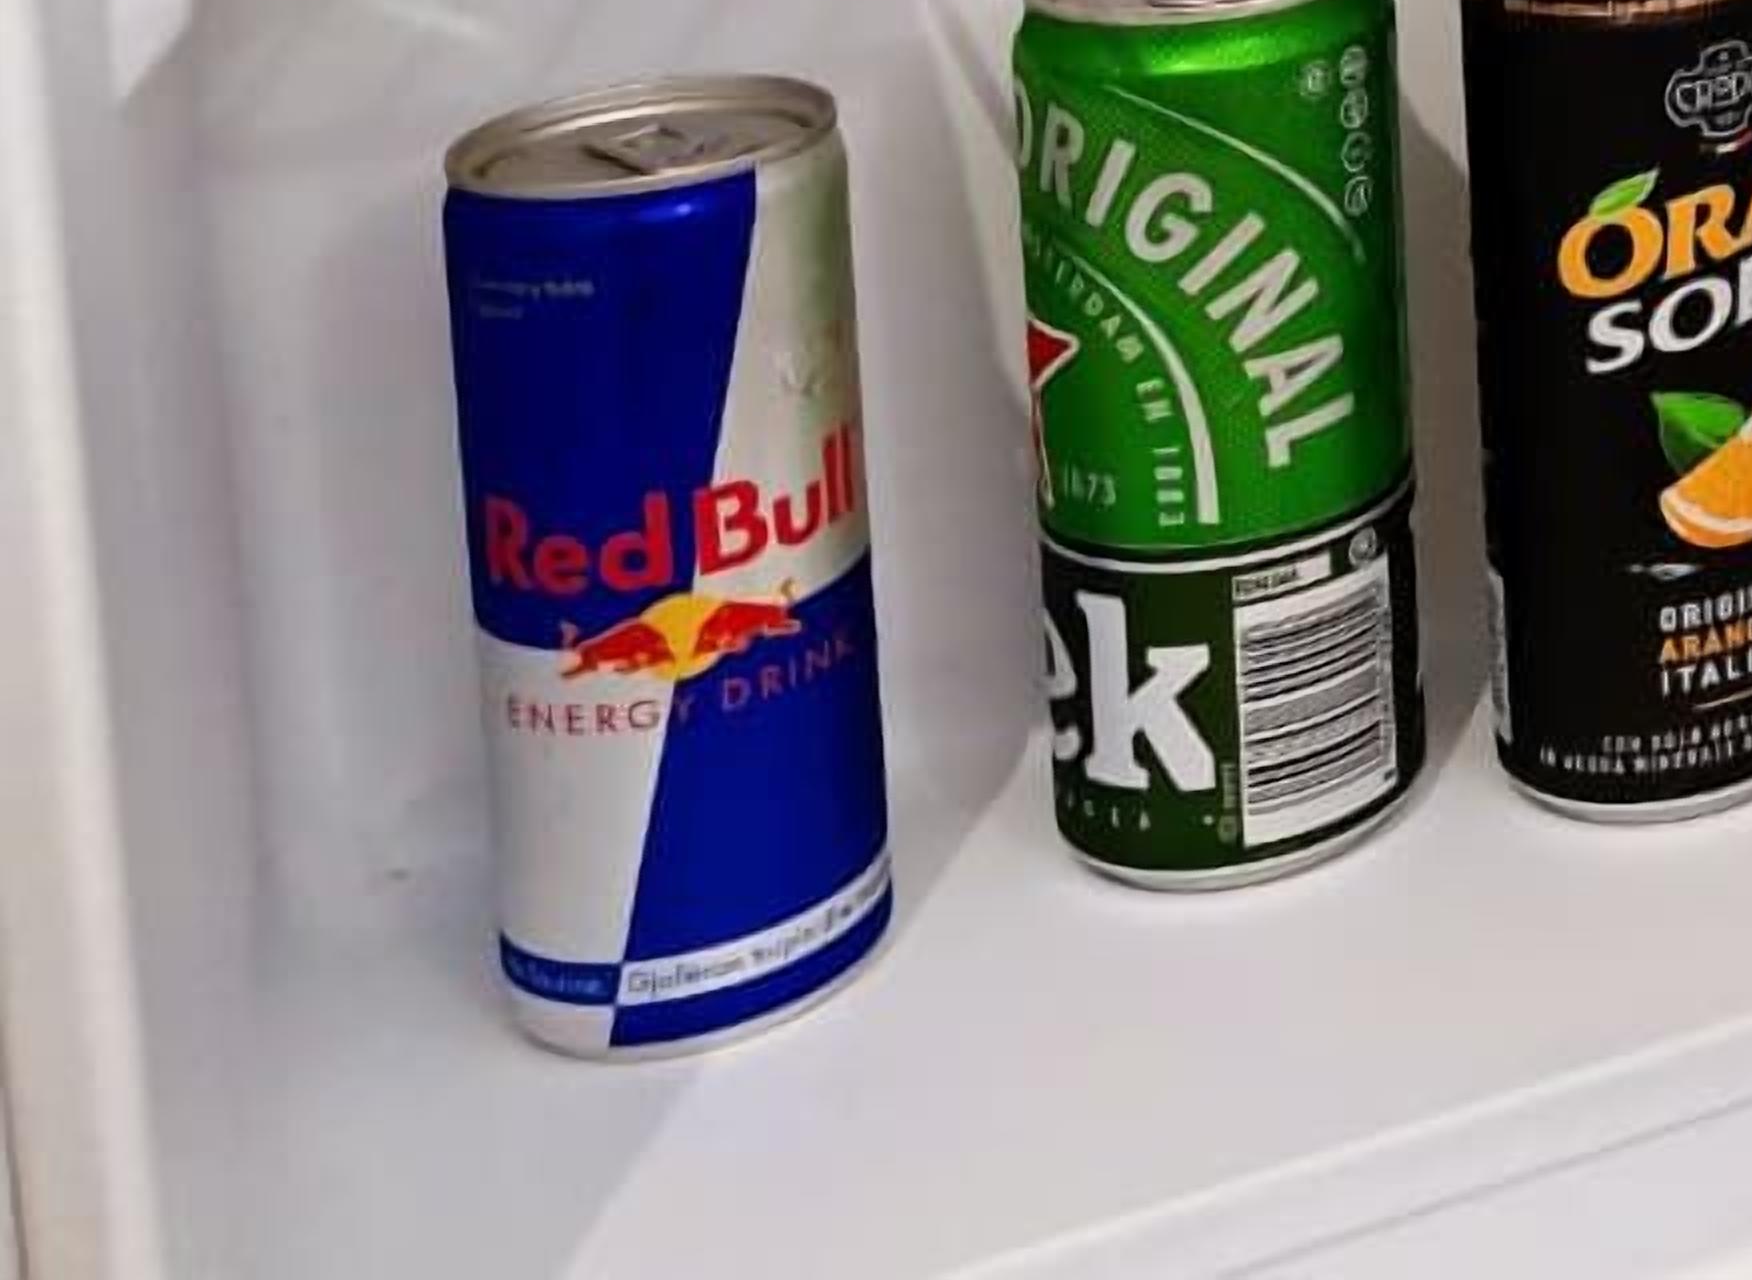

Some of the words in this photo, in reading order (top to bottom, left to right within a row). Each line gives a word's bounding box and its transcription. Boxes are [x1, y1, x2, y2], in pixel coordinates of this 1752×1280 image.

[484, 490, 673, 597] Red
[694, 421, 856, 576] Bull
[507, 694, 695, 737] ENERGY
[722, 627, 857, 712] DRINK
